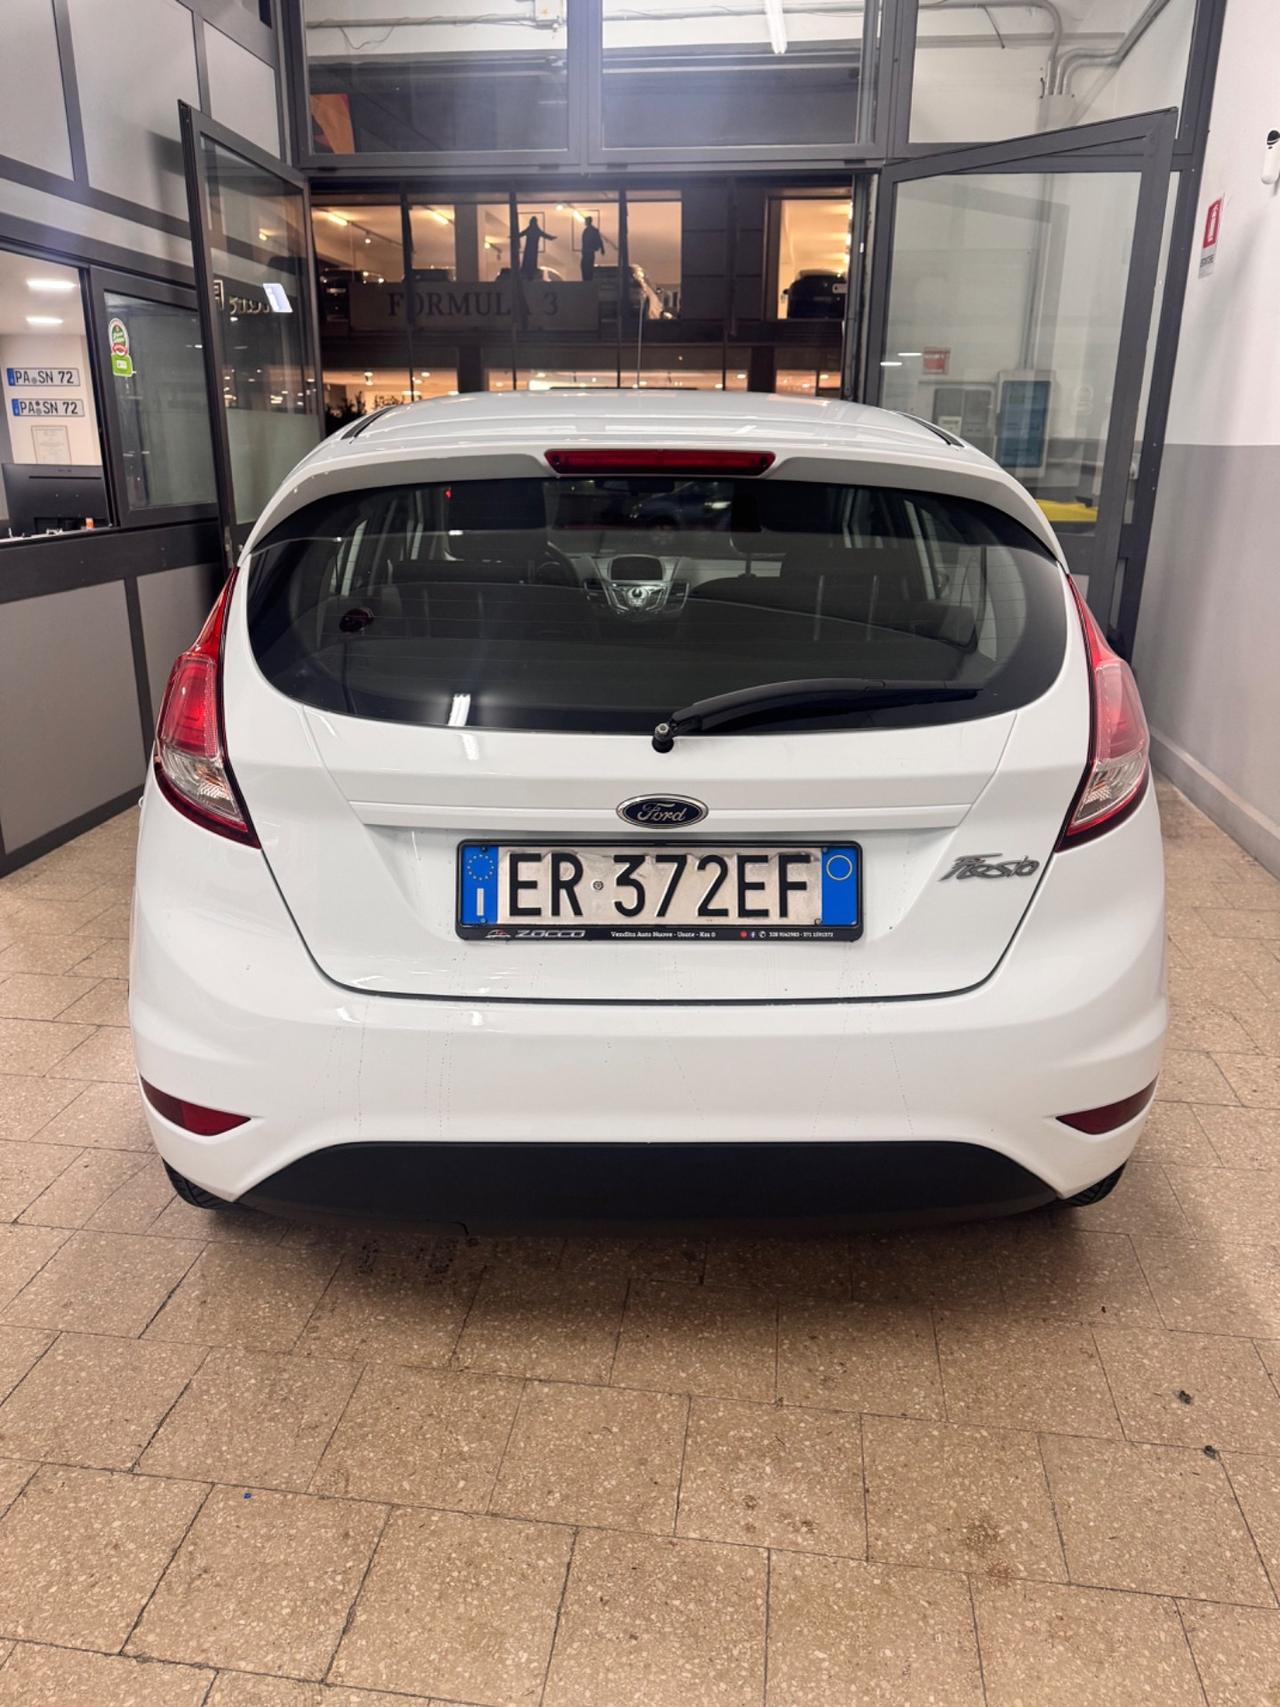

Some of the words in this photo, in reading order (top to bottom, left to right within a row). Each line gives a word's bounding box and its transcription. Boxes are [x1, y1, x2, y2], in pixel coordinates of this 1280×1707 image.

[387, 292, 533, 316] FRMUL
[543, 292, 559, 316] 3
[15, 371, 31, 384] PA
[38, 371, 53, 384] SN
[58, 371, 74, 384] 72
[20, 402, 36, 414] PA
[43, 402, 58, 414] SN
[63, 402, 78, 415] 72
[637, 803, 687, 821] Ford
[509, 853, 583, 917] ER
[613, 854, 812, 918] 372EF
[515, 930, 586, 938] ZOCCO
